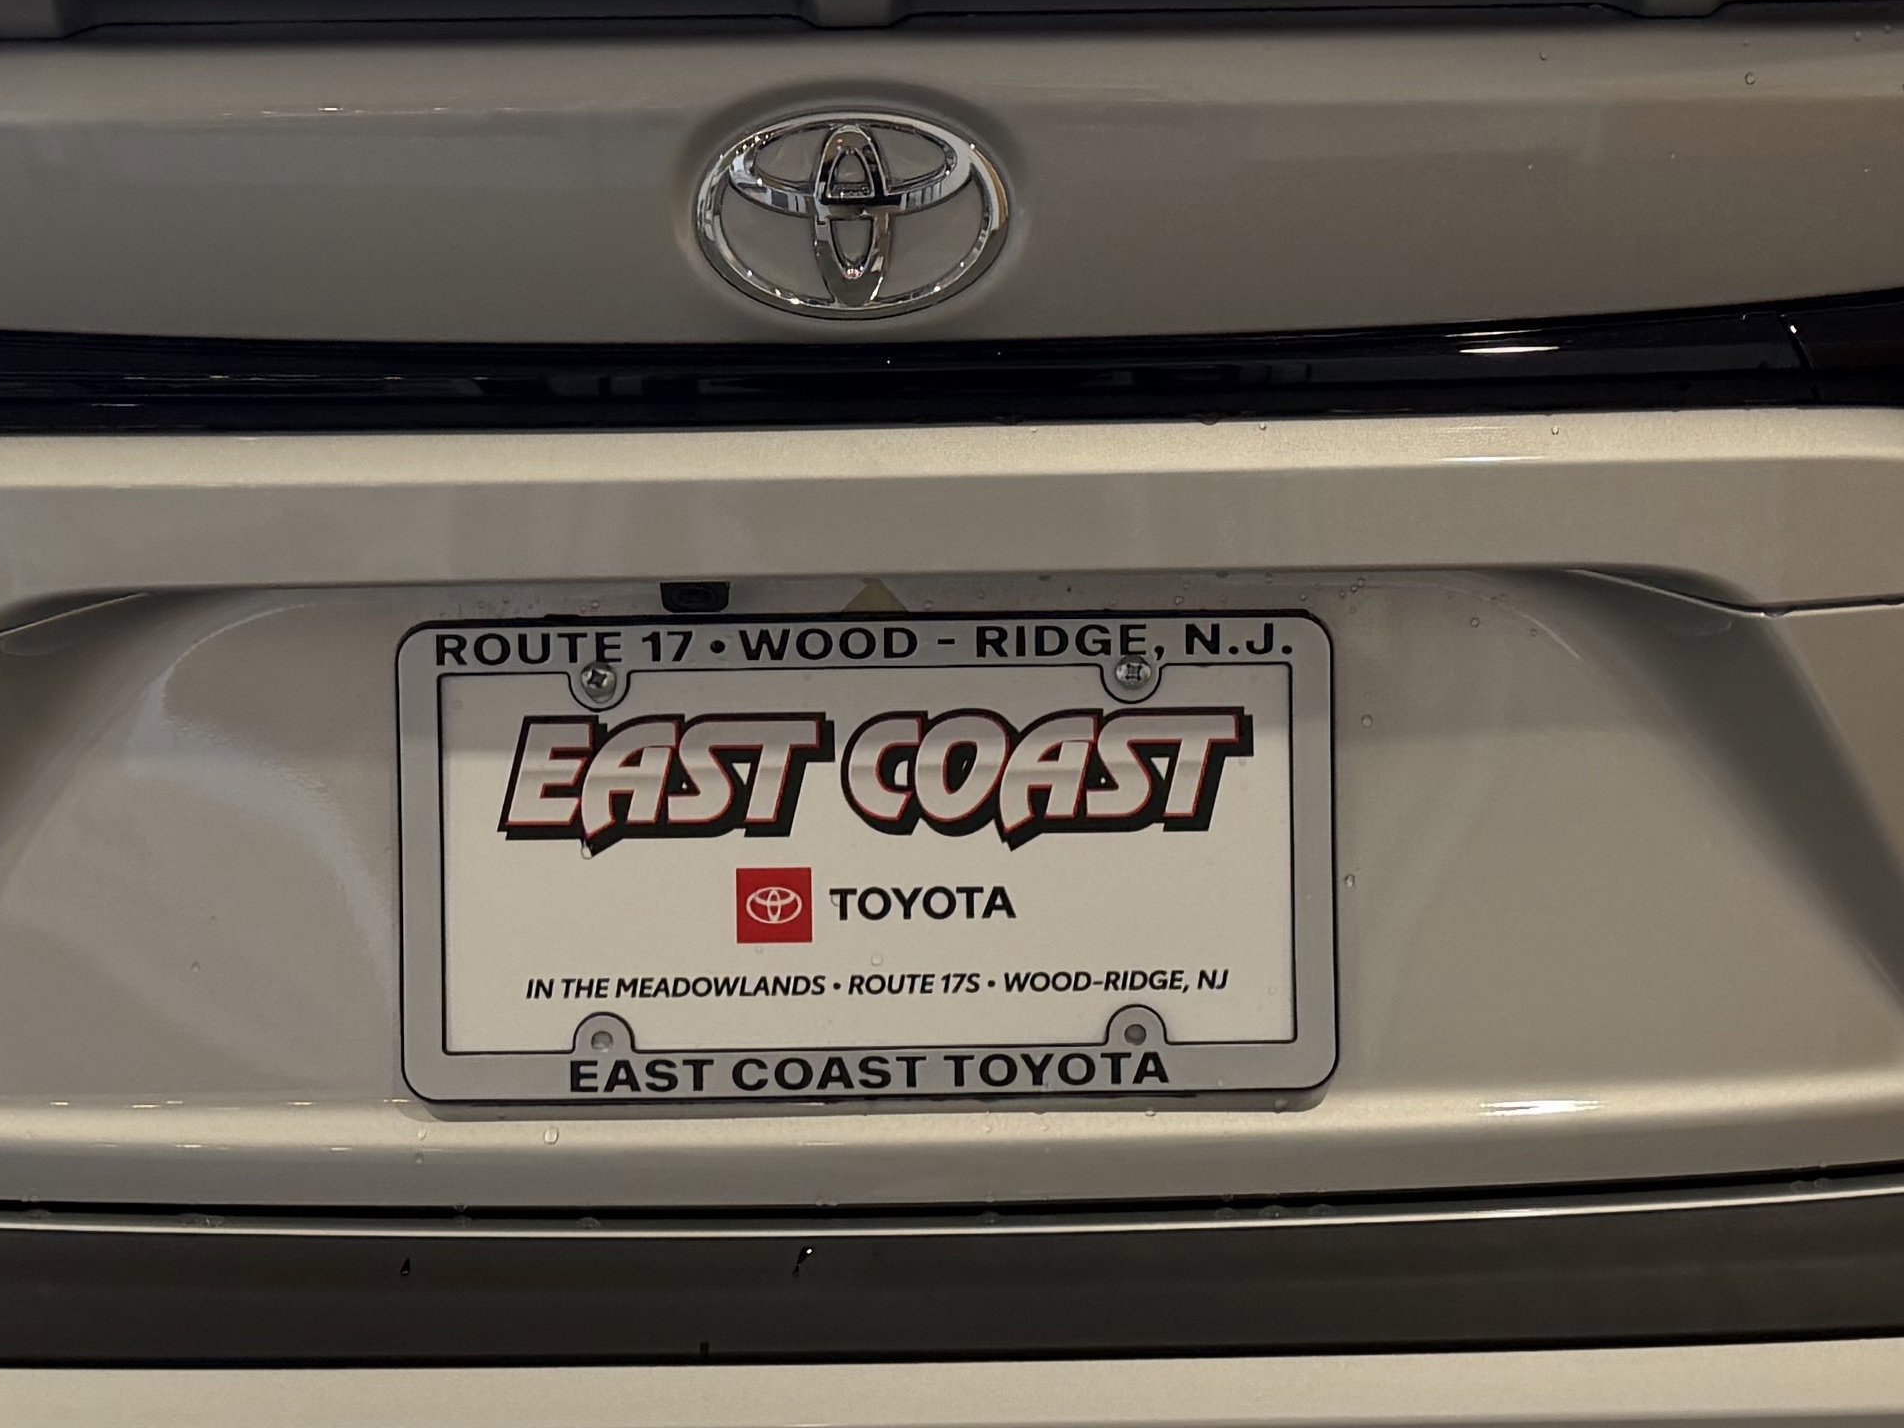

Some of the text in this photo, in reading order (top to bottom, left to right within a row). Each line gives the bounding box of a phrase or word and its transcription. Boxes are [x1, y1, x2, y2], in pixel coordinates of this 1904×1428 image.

[435, 631, 623, 666] ROUTE
[641, 630, 694, 663] 17
[738, 626, 918, 662] WOOD
[976, 623, 1165, 660] RIDGE,
[1185, 622, 1293, 657] N.J.
[497, 706, 1254, 856] EAST COAST
[829, 885, 1017, 922] TOYOTA
[526, 968, 1229, 999] IN THE MEADOWLANDS ROUTE 17S WOOD-RIDGE, NJ
[569, 1050, 1170, 1094] EAST COAST TOYOTA
